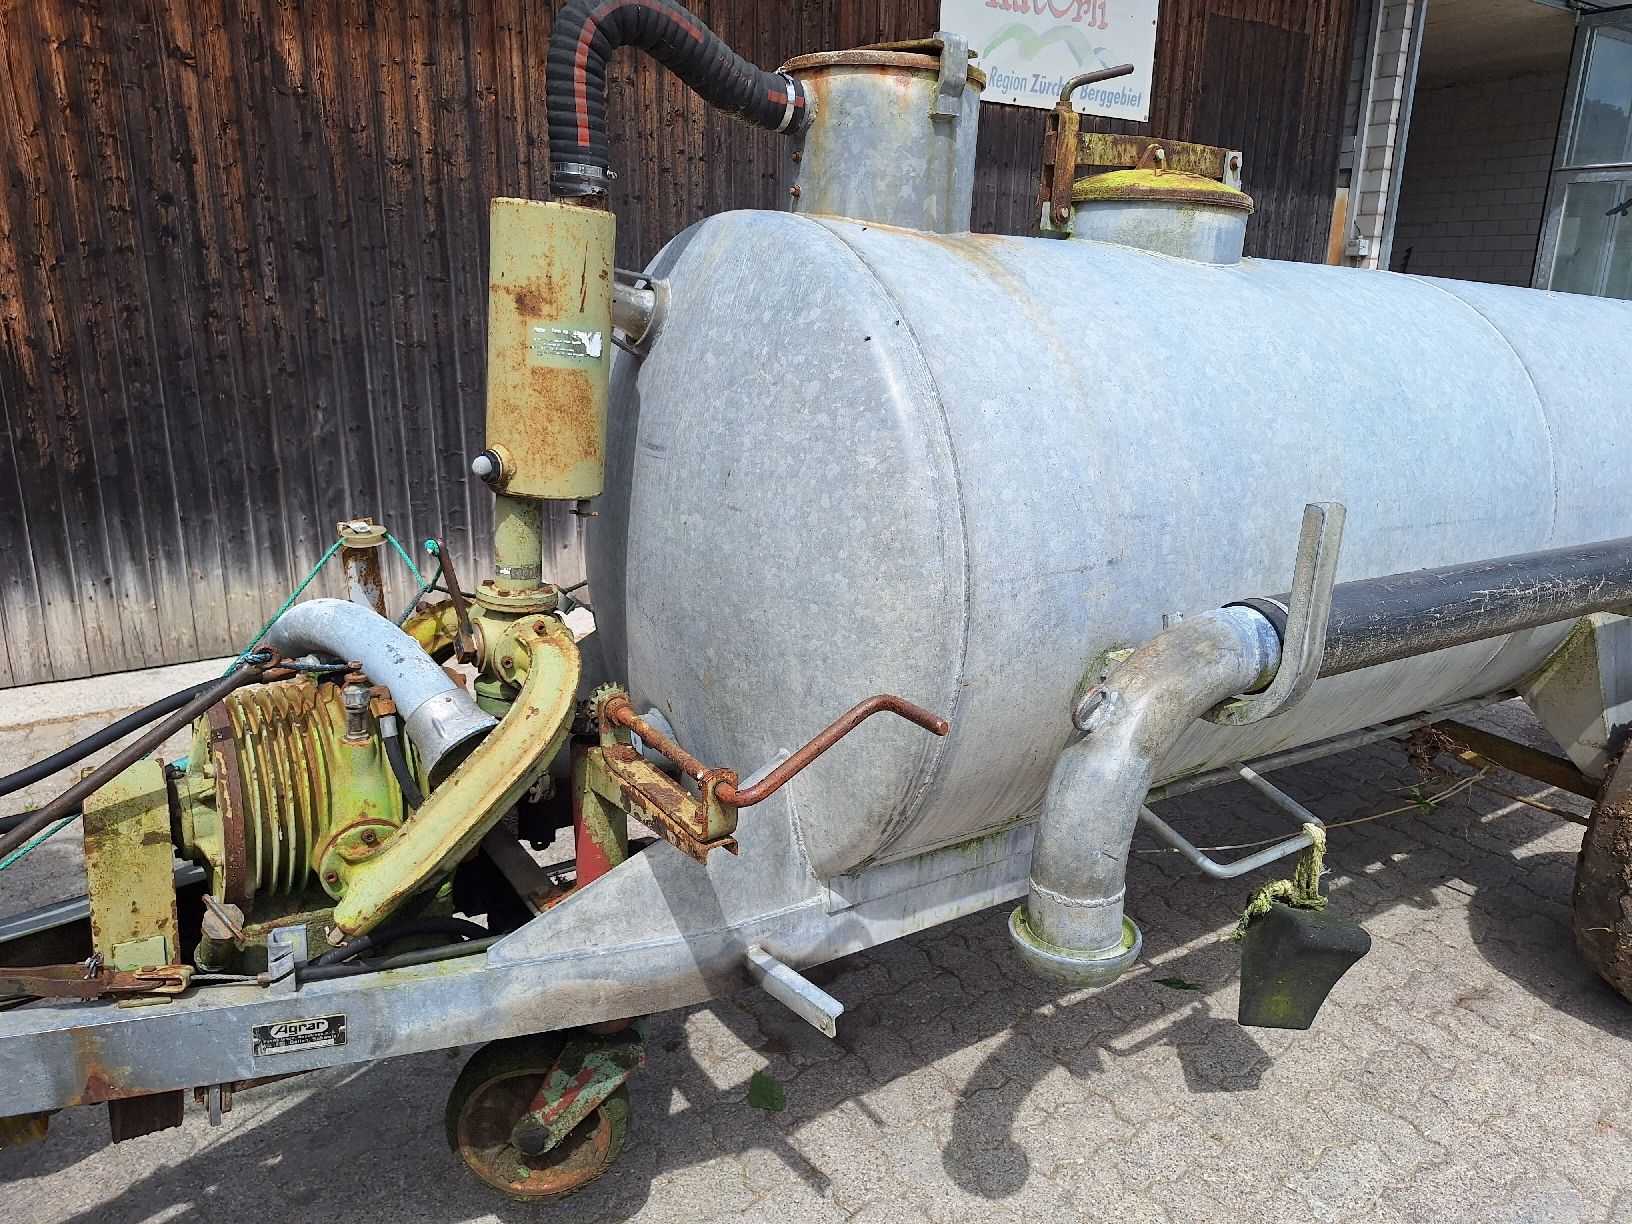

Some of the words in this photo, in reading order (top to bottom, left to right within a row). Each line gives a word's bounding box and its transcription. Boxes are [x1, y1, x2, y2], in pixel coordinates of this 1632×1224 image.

[988, 66, 1027, 95] Region
[1030, 73, 1066, 97] Zürch
[1080, 84, 1142, 108] Berggebiet
[273, 1021, 325, 1036] Agrar
